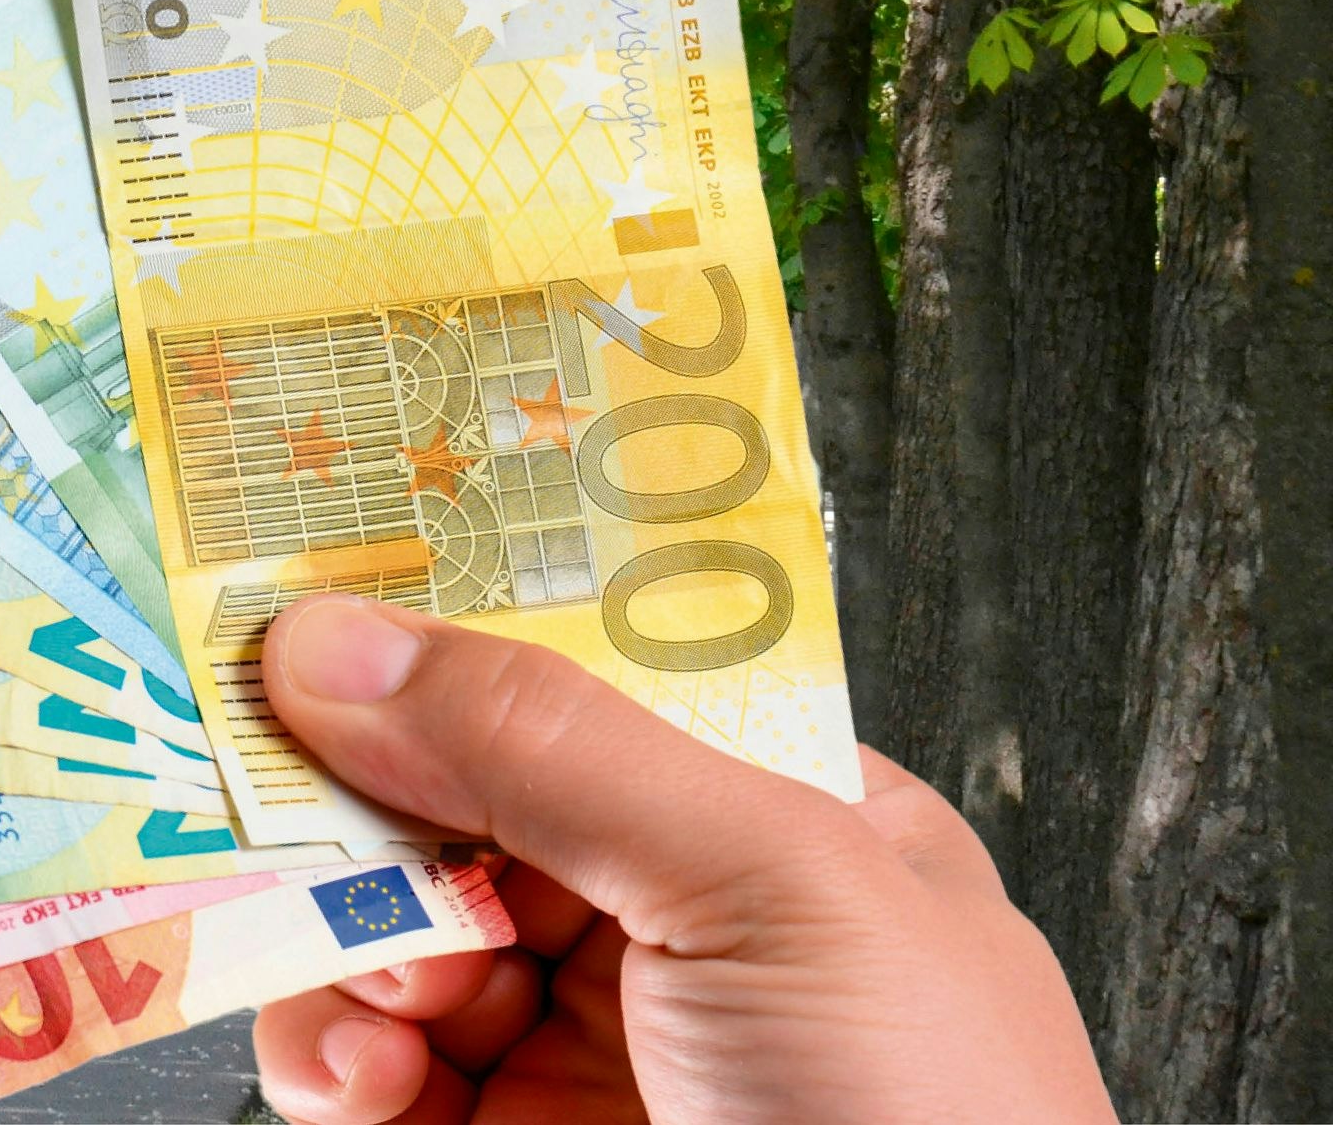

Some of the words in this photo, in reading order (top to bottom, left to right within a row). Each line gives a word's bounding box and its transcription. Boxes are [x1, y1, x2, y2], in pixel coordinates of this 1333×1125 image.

[681, 18, 702, 62] EZB
[688, 74, 710, 117] EKT
[695, 128, 716, 172] EKP
[707, 181, 726, 219] 2002
[549, 264, 794, 673] 200
[421, 861, 446, 889] BC
[23, 902, 60, 925] EKP
